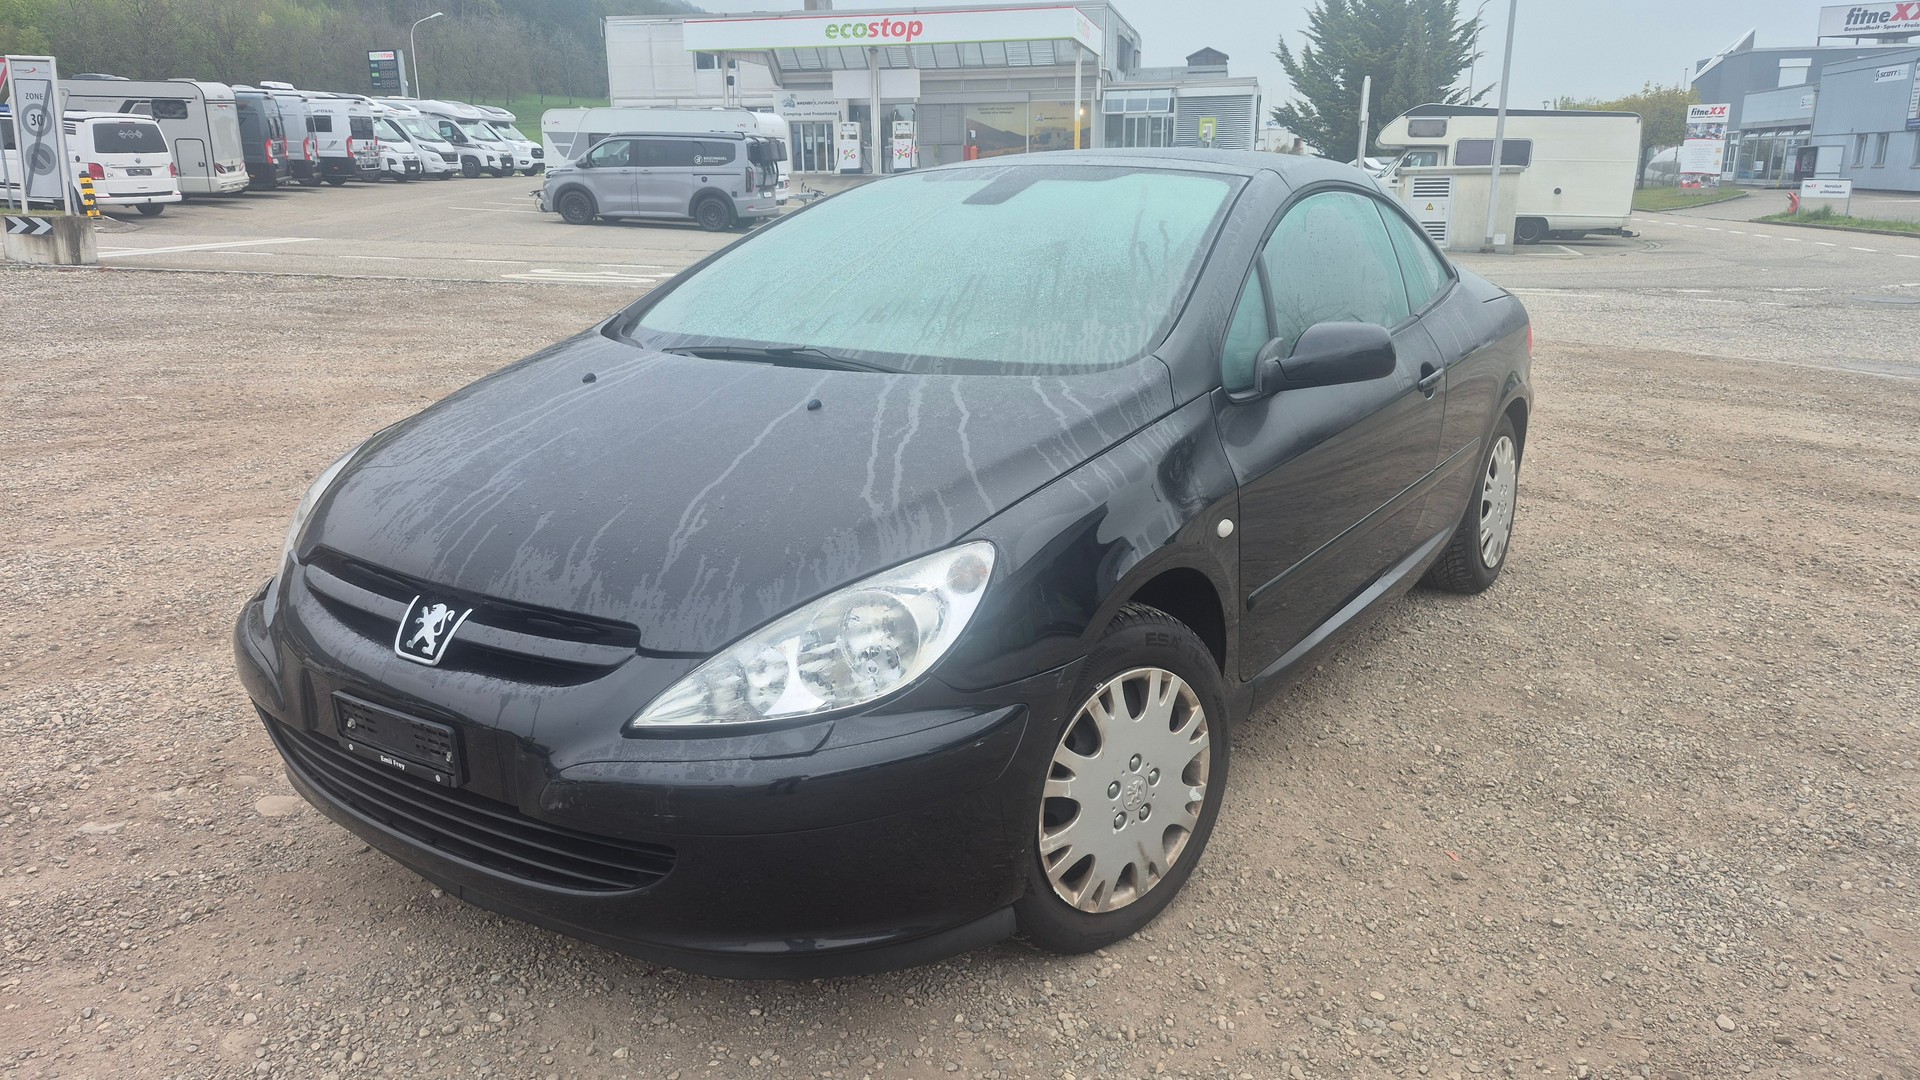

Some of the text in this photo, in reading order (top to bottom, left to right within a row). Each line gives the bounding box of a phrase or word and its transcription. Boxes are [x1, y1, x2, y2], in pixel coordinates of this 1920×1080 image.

[825, 18, 923, 42] ecostop
[1880, 70, 1898, 78] SCOTT
[25, 92, 43, 100] ZONE
[1690, 106, 1727, 116] fitneXX
[30, 113, 43, 126] 30
[380, 754, 405, 771] Emil Frey
